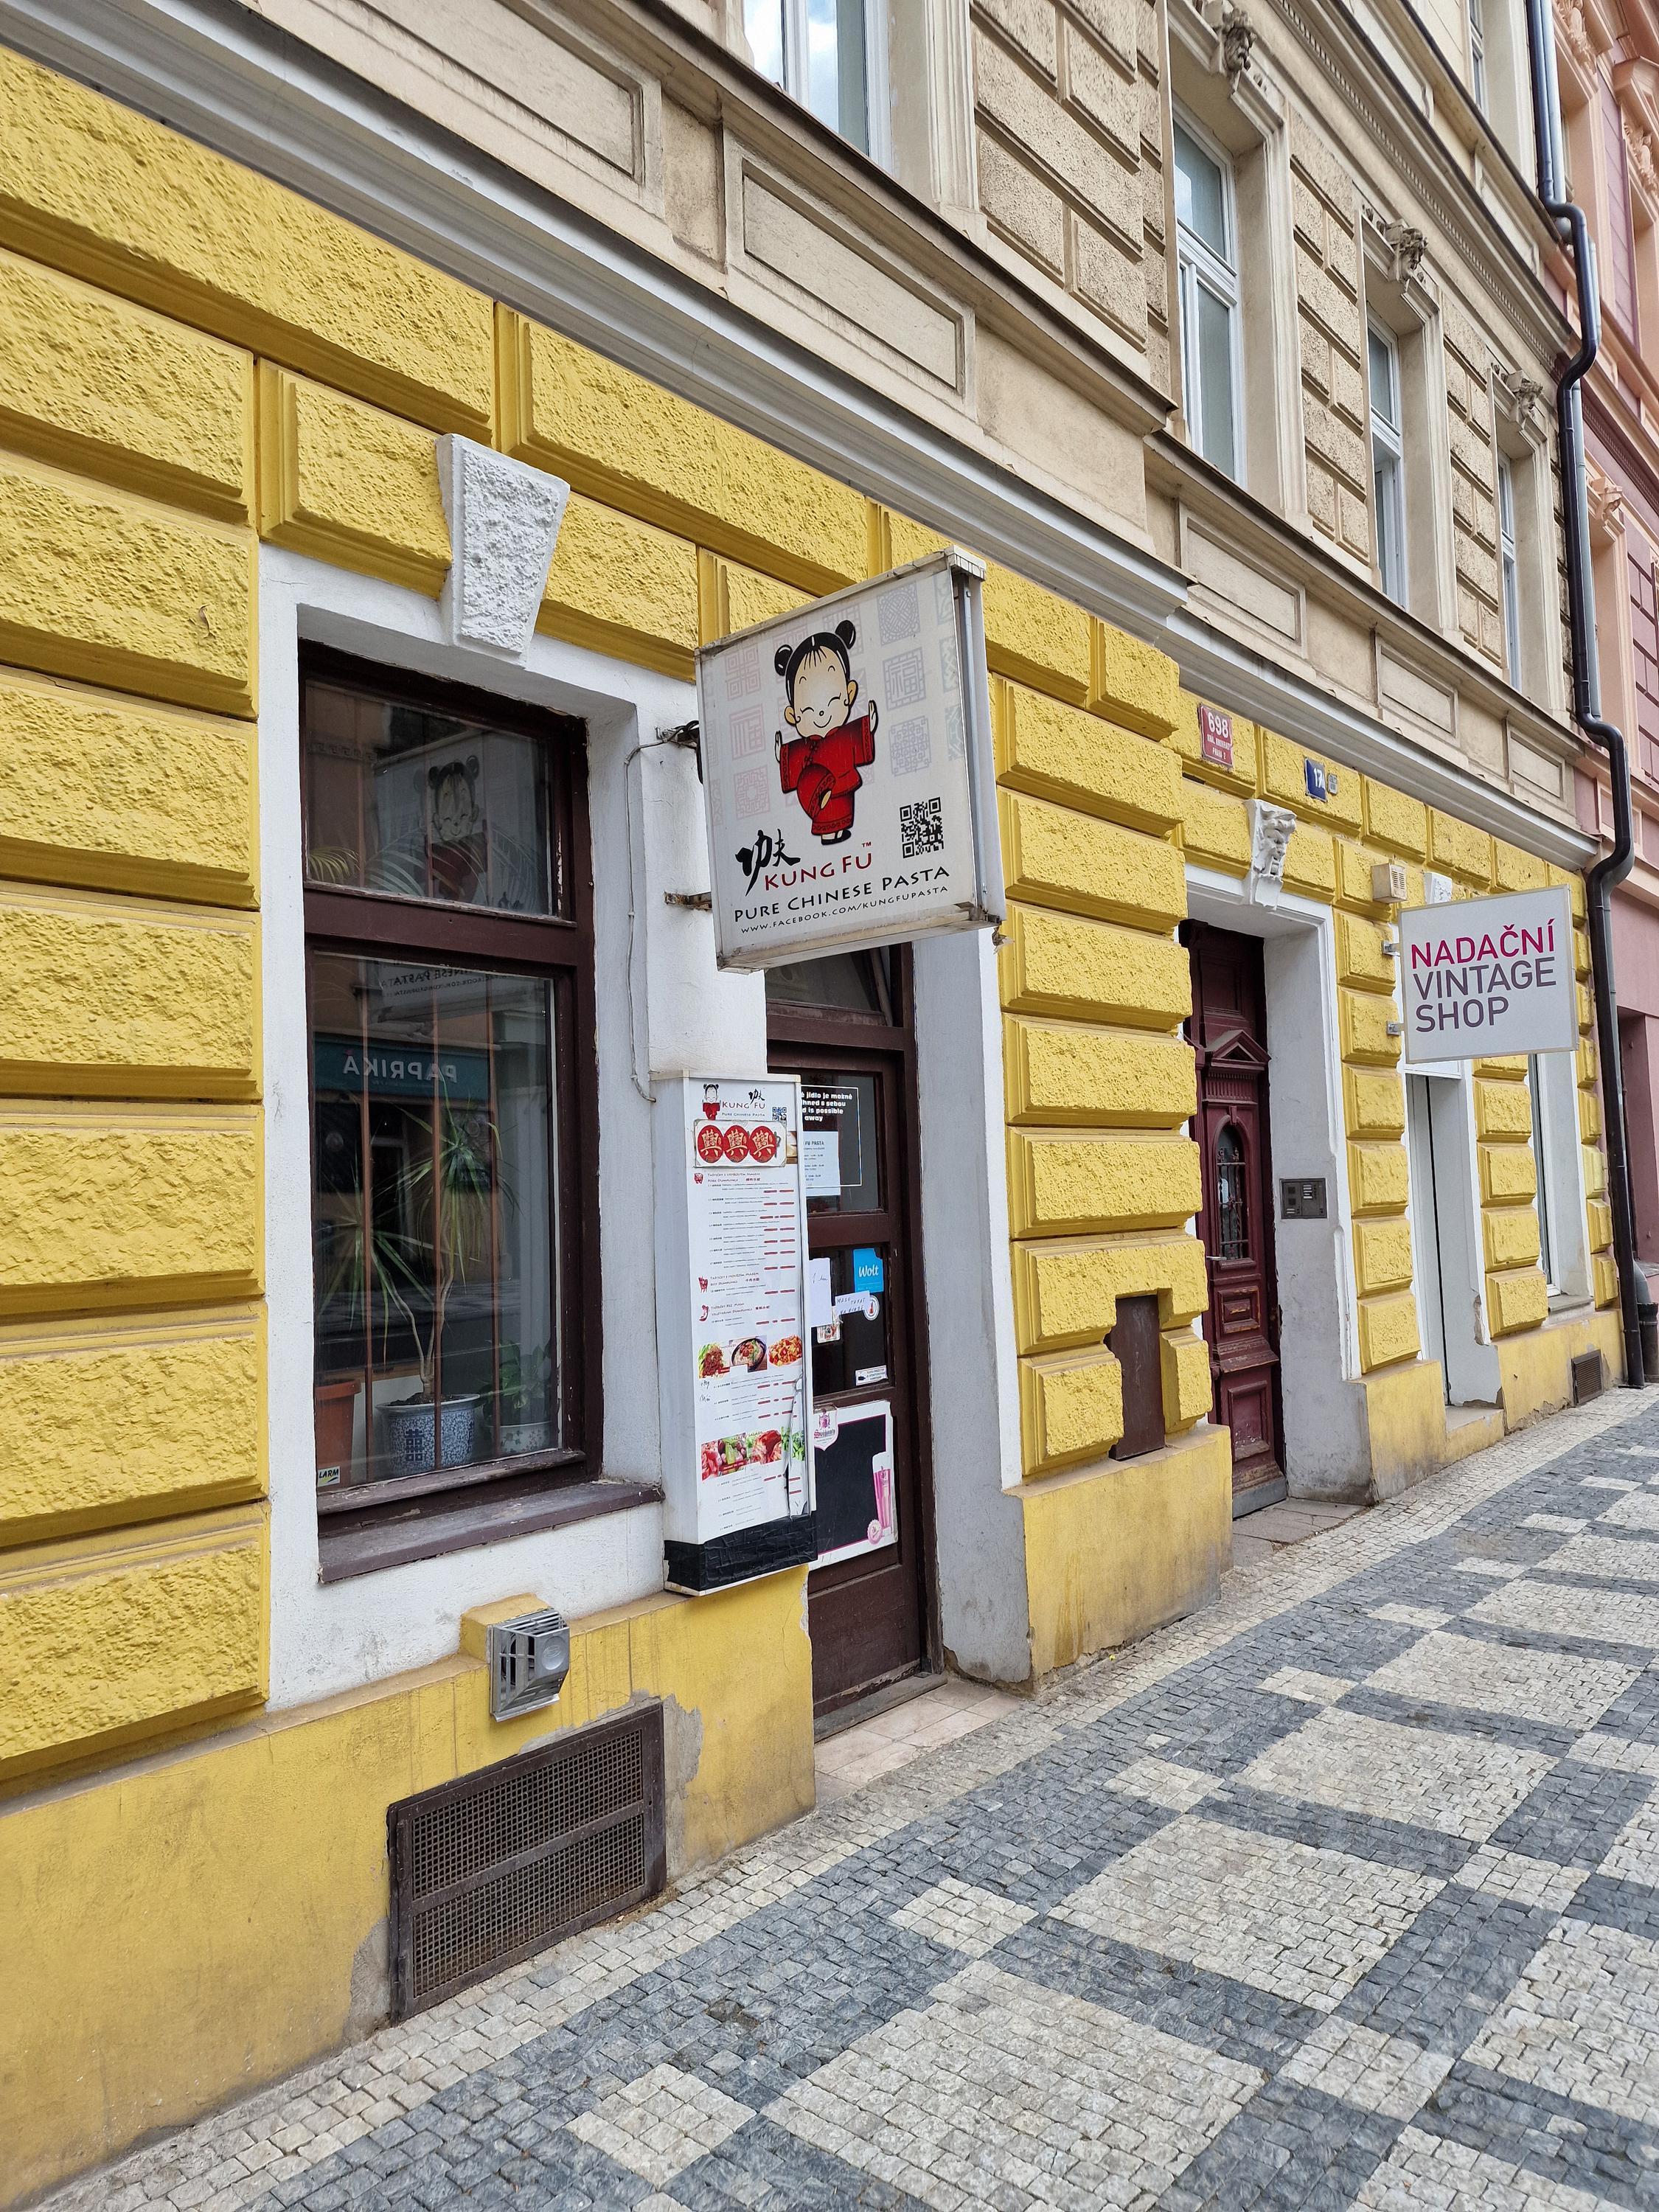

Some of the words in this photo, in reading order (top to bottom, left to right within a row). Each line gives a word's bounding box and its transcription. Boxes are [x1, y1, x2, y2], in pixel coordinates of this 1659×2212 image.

[1208, 712, 1229, 738] 698
[1223, 751, 1227, 760] 2
[765, 862, 835, 891] KUNG
[842, 852, 872, 874] FU
[734, 902, 780, 922] PURE
[787, 882, 872, 911] CHINESE
[882, 866, 950, 891] PASTA
[740, 885, 949, 934] WWW.FACEBOOK.COM/KUNGFUPASTA
[1411, 918, 1556, 970] NADAČNÍ
[1413, 956, 1557, 1001] VINTAGE
[1415, 996, 1509, 1033] SHOP
[858, 1265, 880, 1277] Wolt
[319, 1468, 339, 1479] LARM
